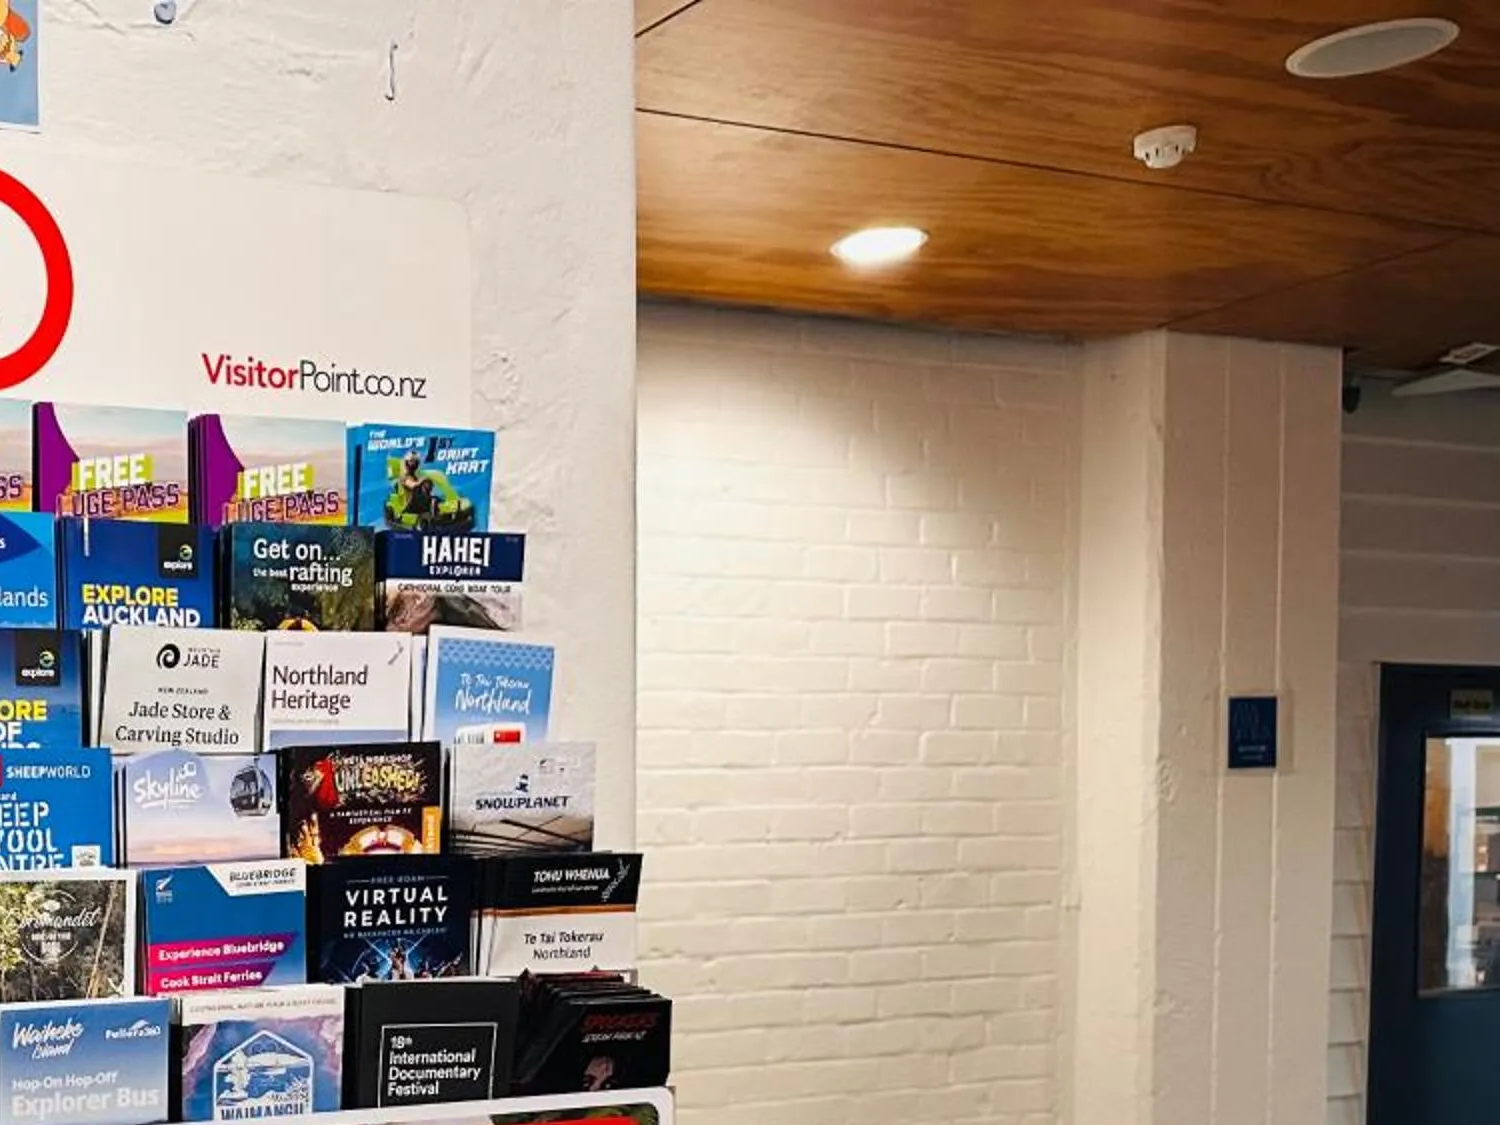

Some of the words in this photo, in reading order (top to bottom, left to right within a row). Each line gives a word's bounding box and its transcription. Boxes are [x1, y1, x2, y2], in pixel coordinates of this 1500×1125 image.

[202, 353, 427, 398] VisitorPoint.co.nz
[79, 454, 145, 490] FREE
[244, 463, 308, 498] FREE
[254, 539, 290, 560] Get
[296, 542, 341, 562] on...
[423, 535, 490, 565] HAHEI
[254, 568, 267, 577] the
[269, 569, 287, 577] best
[289, 563, 352, 587] rafting
[82, 584, 178, 606] EXPLORE
[291, 582, 338, 592] experience
[82, 606, 200, 628] AUCKLAND
[184, 654, 219, 668] JADE
[272, 665, 367, 686] Northland
[271, 690, 351, 715] Heritage
[455, 686, 532, 714] Northland
[129, 702, 169, 719] Jade
[172, 704, 215, 720] Store
[218, 706, 231, 720] &
[116, 726, 181, 746] Carving
[185, 729, 239, 745] Studio
[7, 766, 90, 778] SHEEPWORLD
[475, 796, 572, 810] SNOWPLANET
[230, 869, 297, 882] BLUEBRIDGE
[534, 871, 562, 883] TOHU
[565, 868, 610, 880] WHENUA
[345, 886, 448, 906] VIRTUAL
[344, 907, 447, 927] REALITY
[159, 947, 220, 962] Experience
[223, 941, 284, 954] Bluebridge
[533, 947, 591, 960] Northland
[161, 976, 189, 988] Cook
[192, 973, 221, 985] Strait
[224, 970, 262, 983] Ferries
[13, 1018, 84, 1048] Waiheke
[390, 1049, 476, 1065] International
[12, 1075, 62, 1091] Hop-On
[66, 1071, 117, 1087] Hop-Off
[389, 1066, 481, 1081] Documentary
[388, 1081, 439, 1096] Festival
[13, 1094, 108, 1119] Explorer
[117, 1087, 159, 1106] Bus
